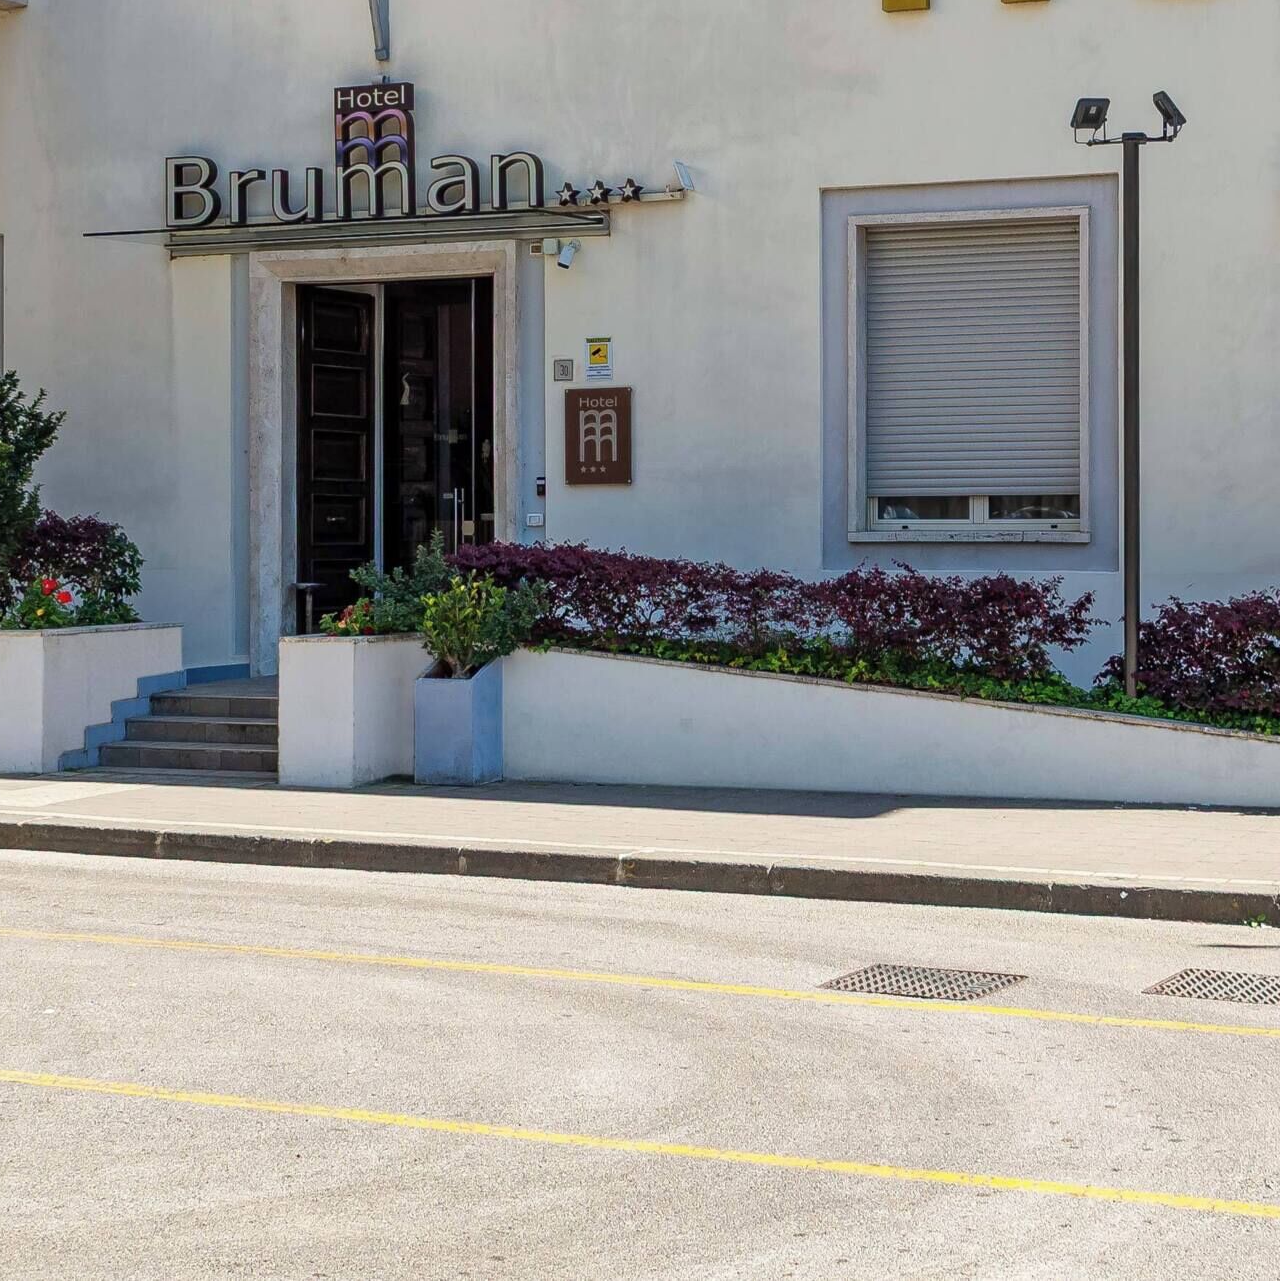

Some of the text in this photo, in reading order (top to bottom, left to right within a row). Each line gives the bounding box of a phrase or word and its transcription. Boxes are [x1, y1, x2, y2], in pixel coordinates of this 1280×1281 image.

[336, 85, 406, 109] Hotel
[165, 109, 545, 227] Bruman
[579, 396, 618, 408] Hotel
